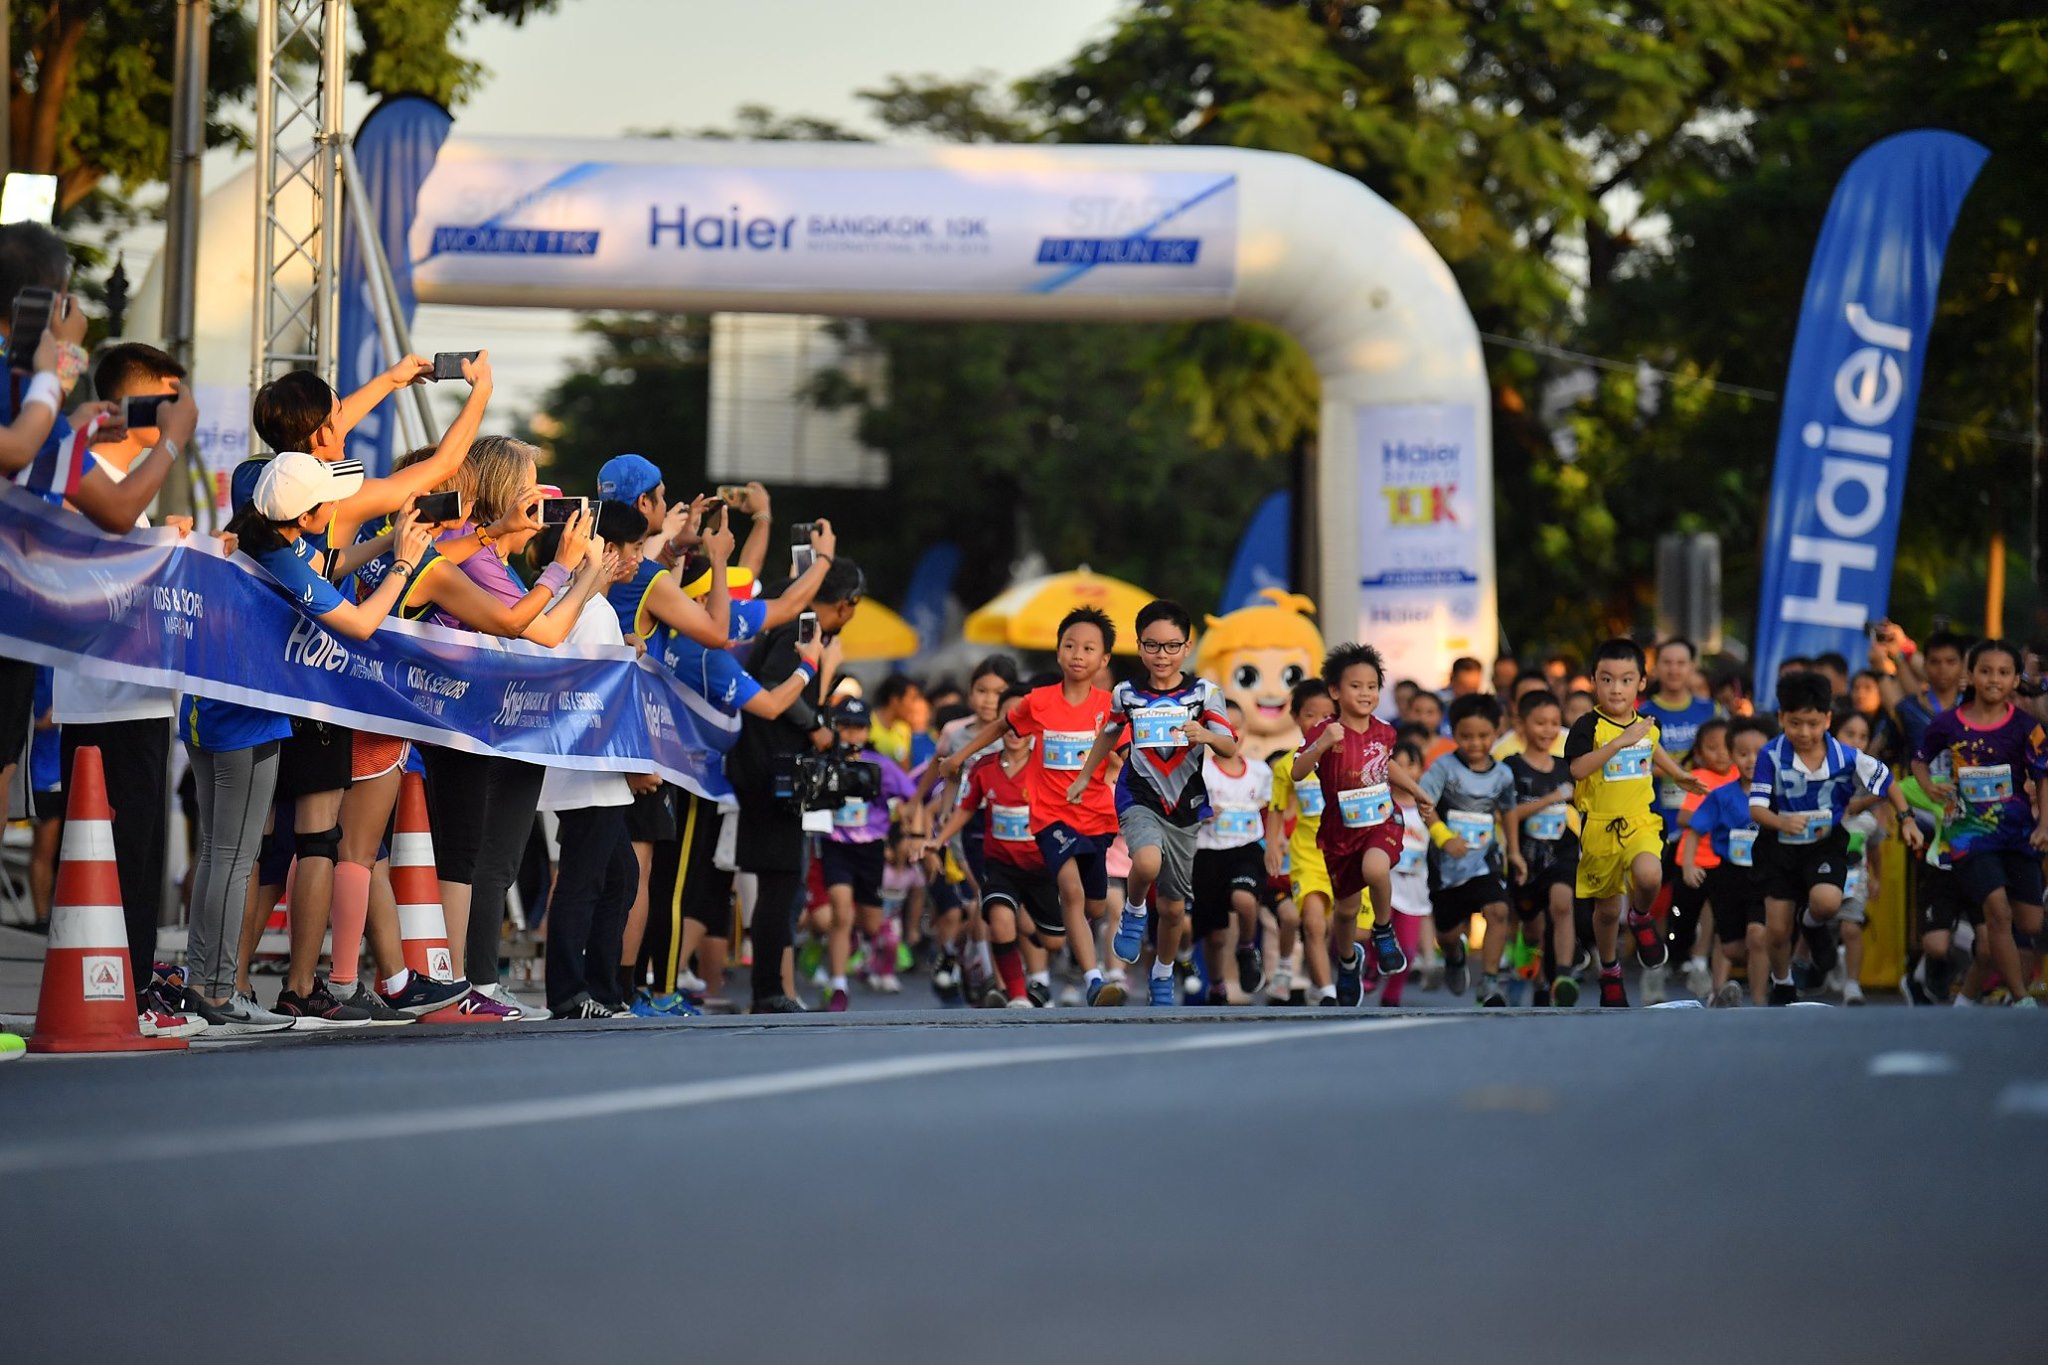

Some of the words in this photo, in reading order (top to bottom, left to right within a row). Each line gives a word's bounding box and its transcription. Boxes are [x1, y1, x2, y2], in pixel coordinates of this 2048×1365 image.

[648, 204, 796, 250] Haier
[196, 422, 248, 449] aier
[1381, 441, 1462, 466] Haier
[1780, 302, 1912, 630] Haier
[285, 614, 350, 675] Haier
[1155, 727, 1165, 741] 1
[1064, 751, 1073, 765] 1
[1626, 760, 1636, 773] 1
[1366, 806, 1376, 820] 1
